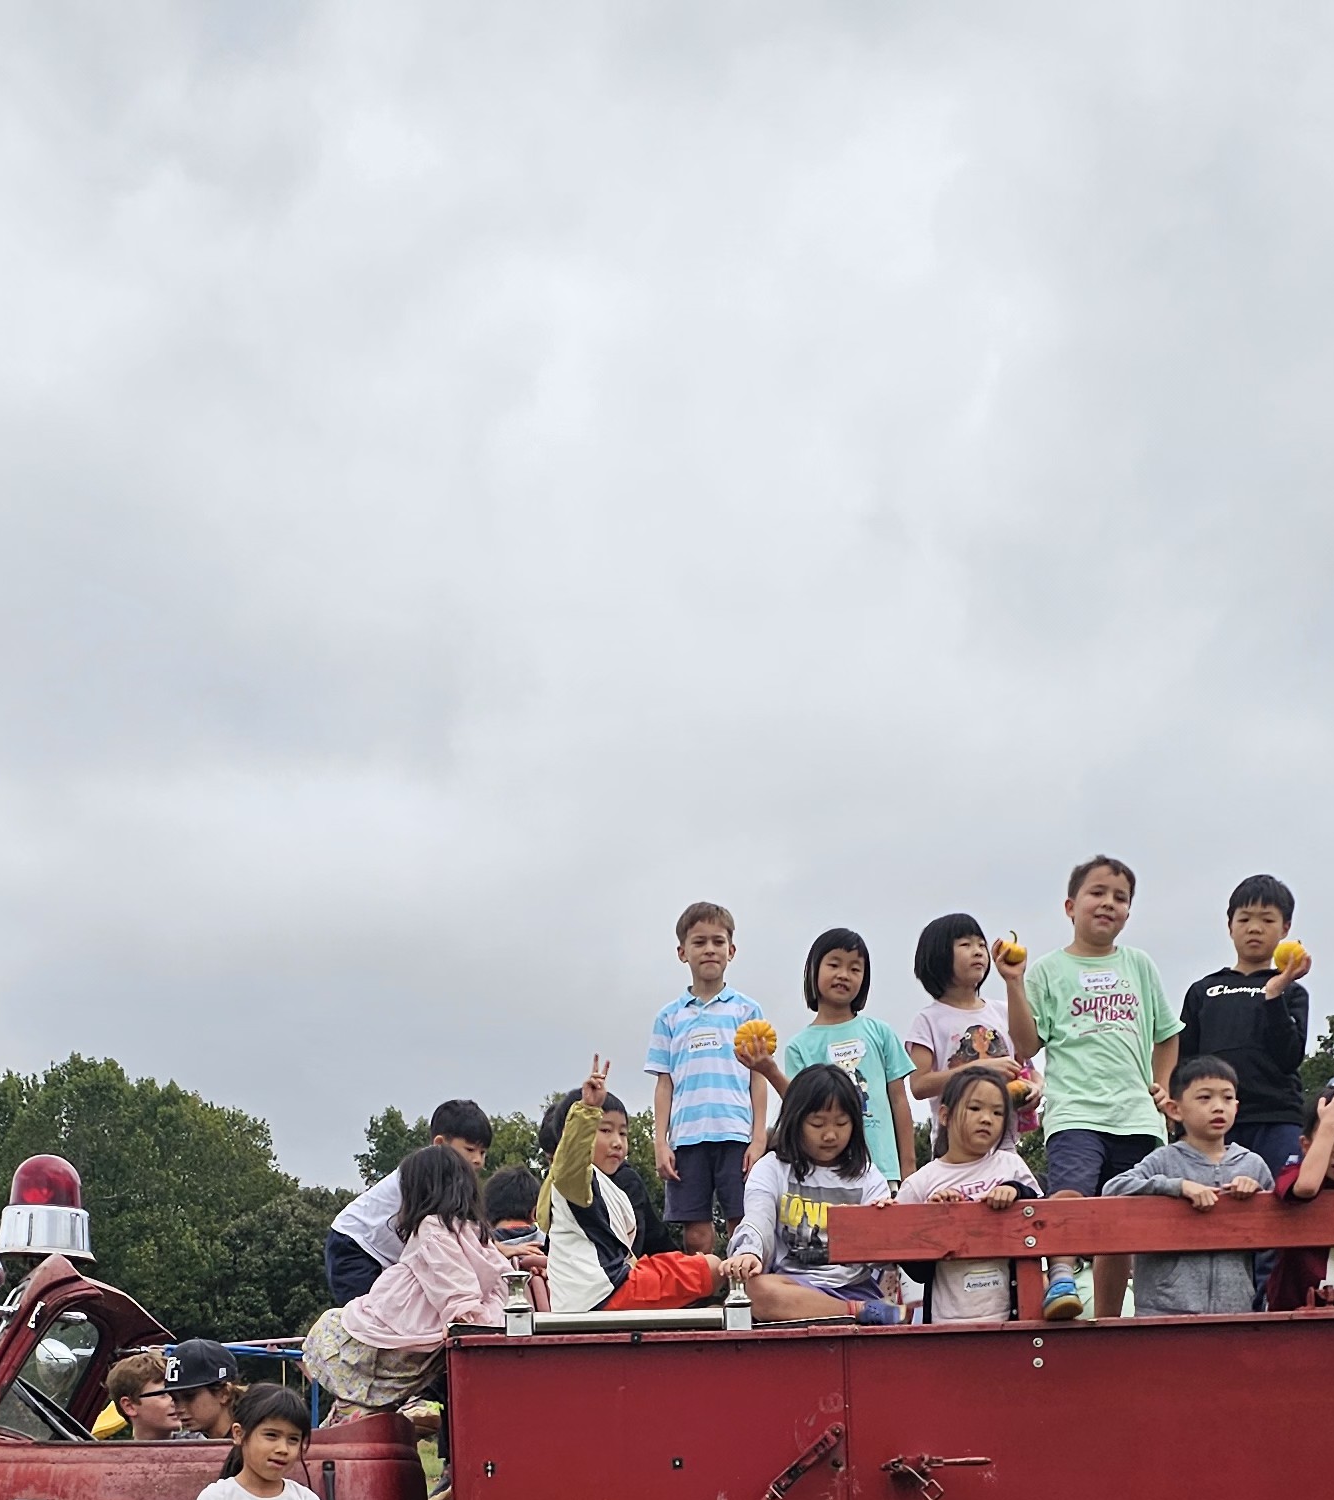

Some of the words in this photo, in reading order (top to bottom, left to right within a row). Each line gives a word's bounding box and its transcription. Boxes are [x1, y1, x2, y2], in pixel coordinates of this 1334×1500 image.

[1071, 993, 1139, 1016] Summer
[1095, 1006, 1136, 1023] Vibes
[966, 1281, 991, 1289] Amber
